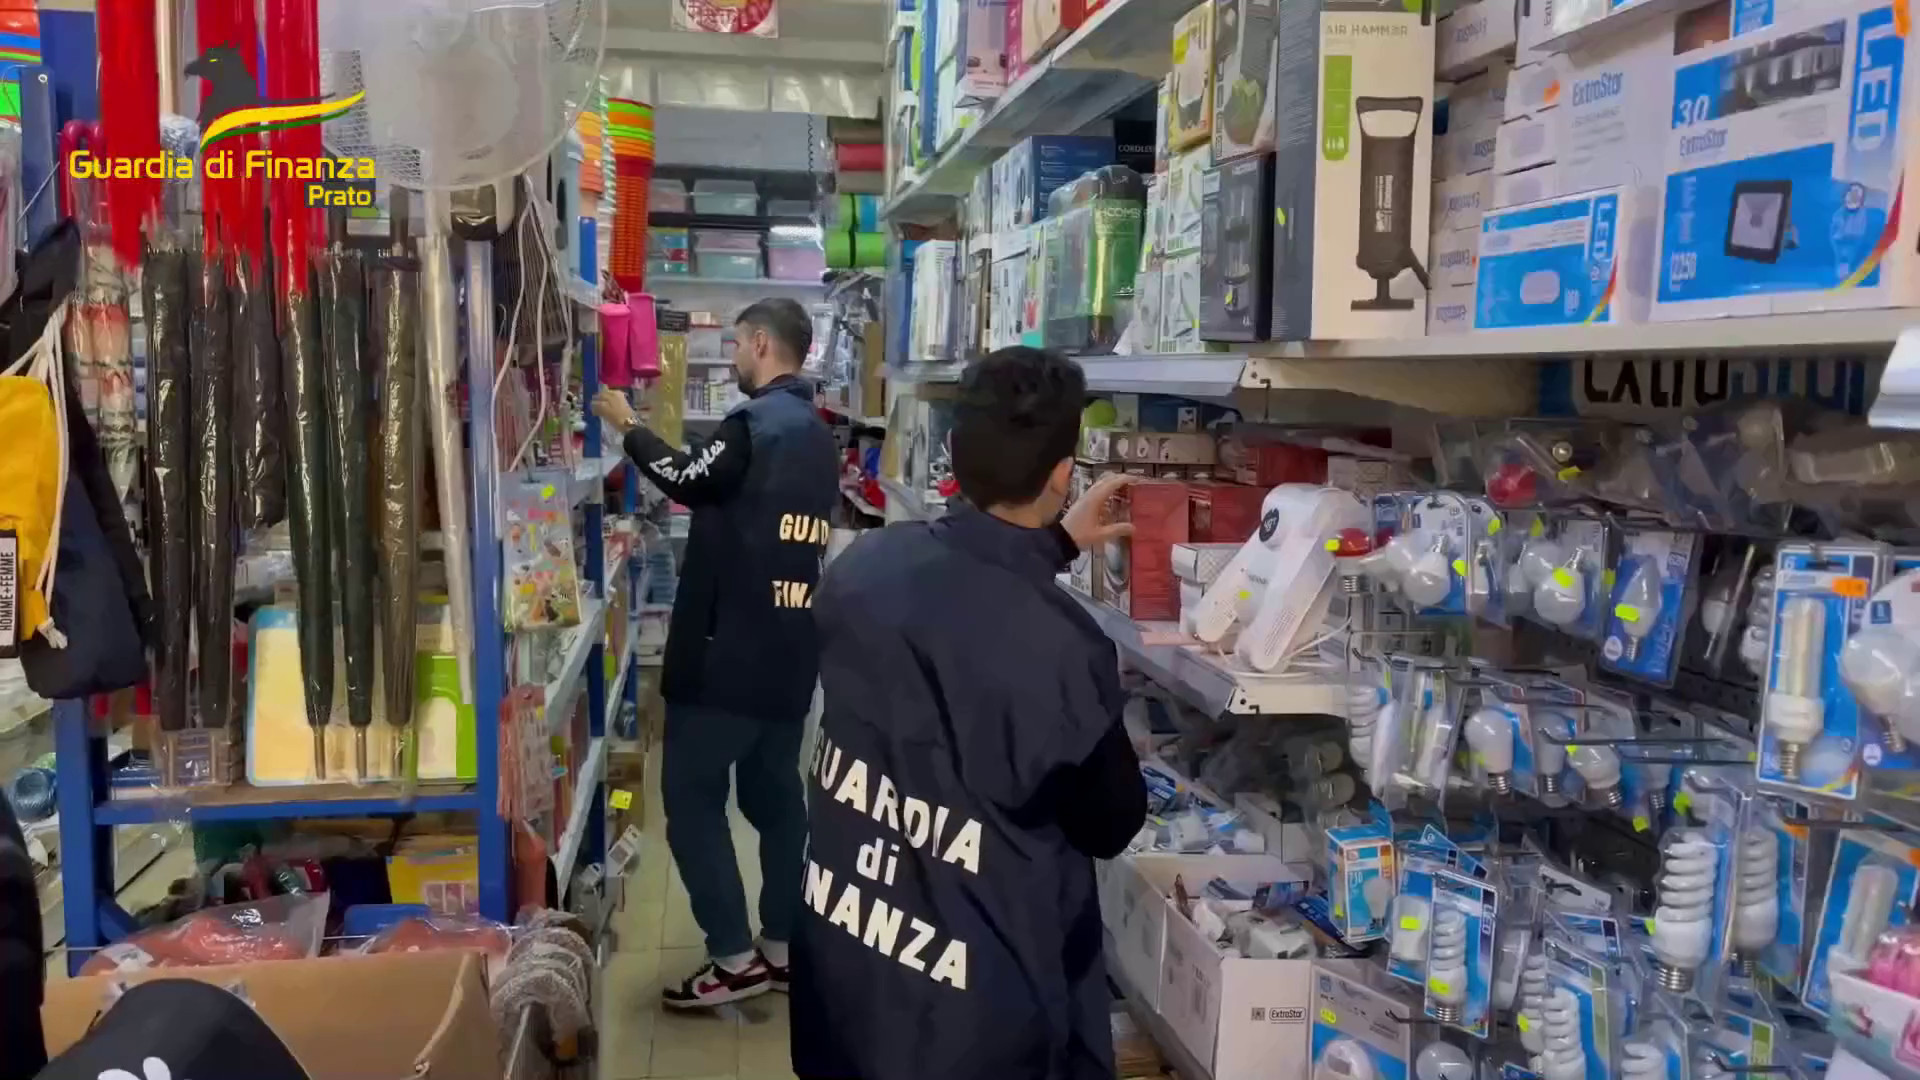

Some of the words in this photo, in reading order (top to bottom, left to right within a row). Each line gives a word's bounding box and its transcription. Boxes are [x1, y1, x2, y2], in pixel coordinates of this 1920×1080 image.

[1852, 23, 1895, 152] LED
[1118, 144, 1156, 153] CORDLES
[0, 552, 14, 631] HOMME+FEMME
[856, 838, 901, 886] di
[1271, 1009, 1303, 1019] ExtraStar
